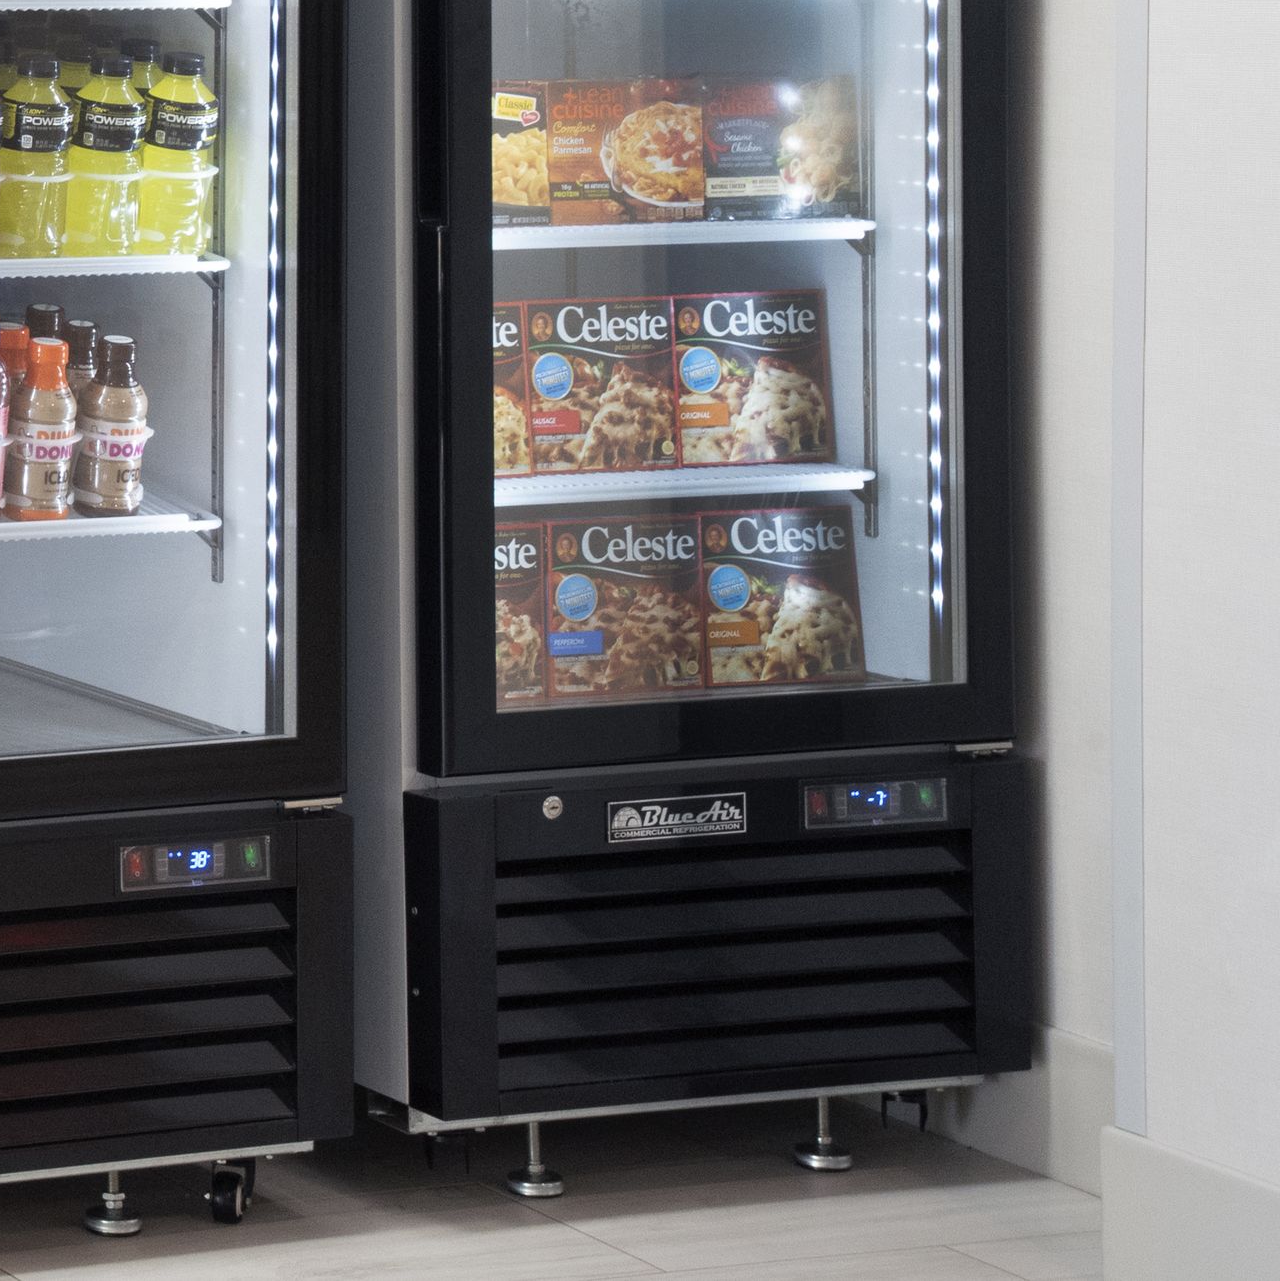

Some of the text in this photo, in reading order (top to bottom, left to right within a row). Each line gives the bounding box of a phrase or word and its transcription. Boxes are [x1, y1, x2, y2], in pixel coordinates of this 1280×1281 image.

[551, 101, 625, 120] cuisine
[552, 120, 597, 135] Comfort
[553, 136, 585, 146] Chicken
[723, 131, 753, 142] Sesame
[553, 146, 592, 155] Parmesan
[730, 142, 762, 153] Chicken
[556, 305, 668, 343] Celeste
[703, 300, 816, 337] Celeste
[680, 411, 711, 421] ORIGINAL
[732, 517, 845, 555] Celeste
[582, 525, 695, 564] Celeste
[709, 629, 740, 639] ORIGINAL
[614, 822, 740, 839] COMMERCIAL REFRIGERATION
[190, 850, 207, 869] 38
